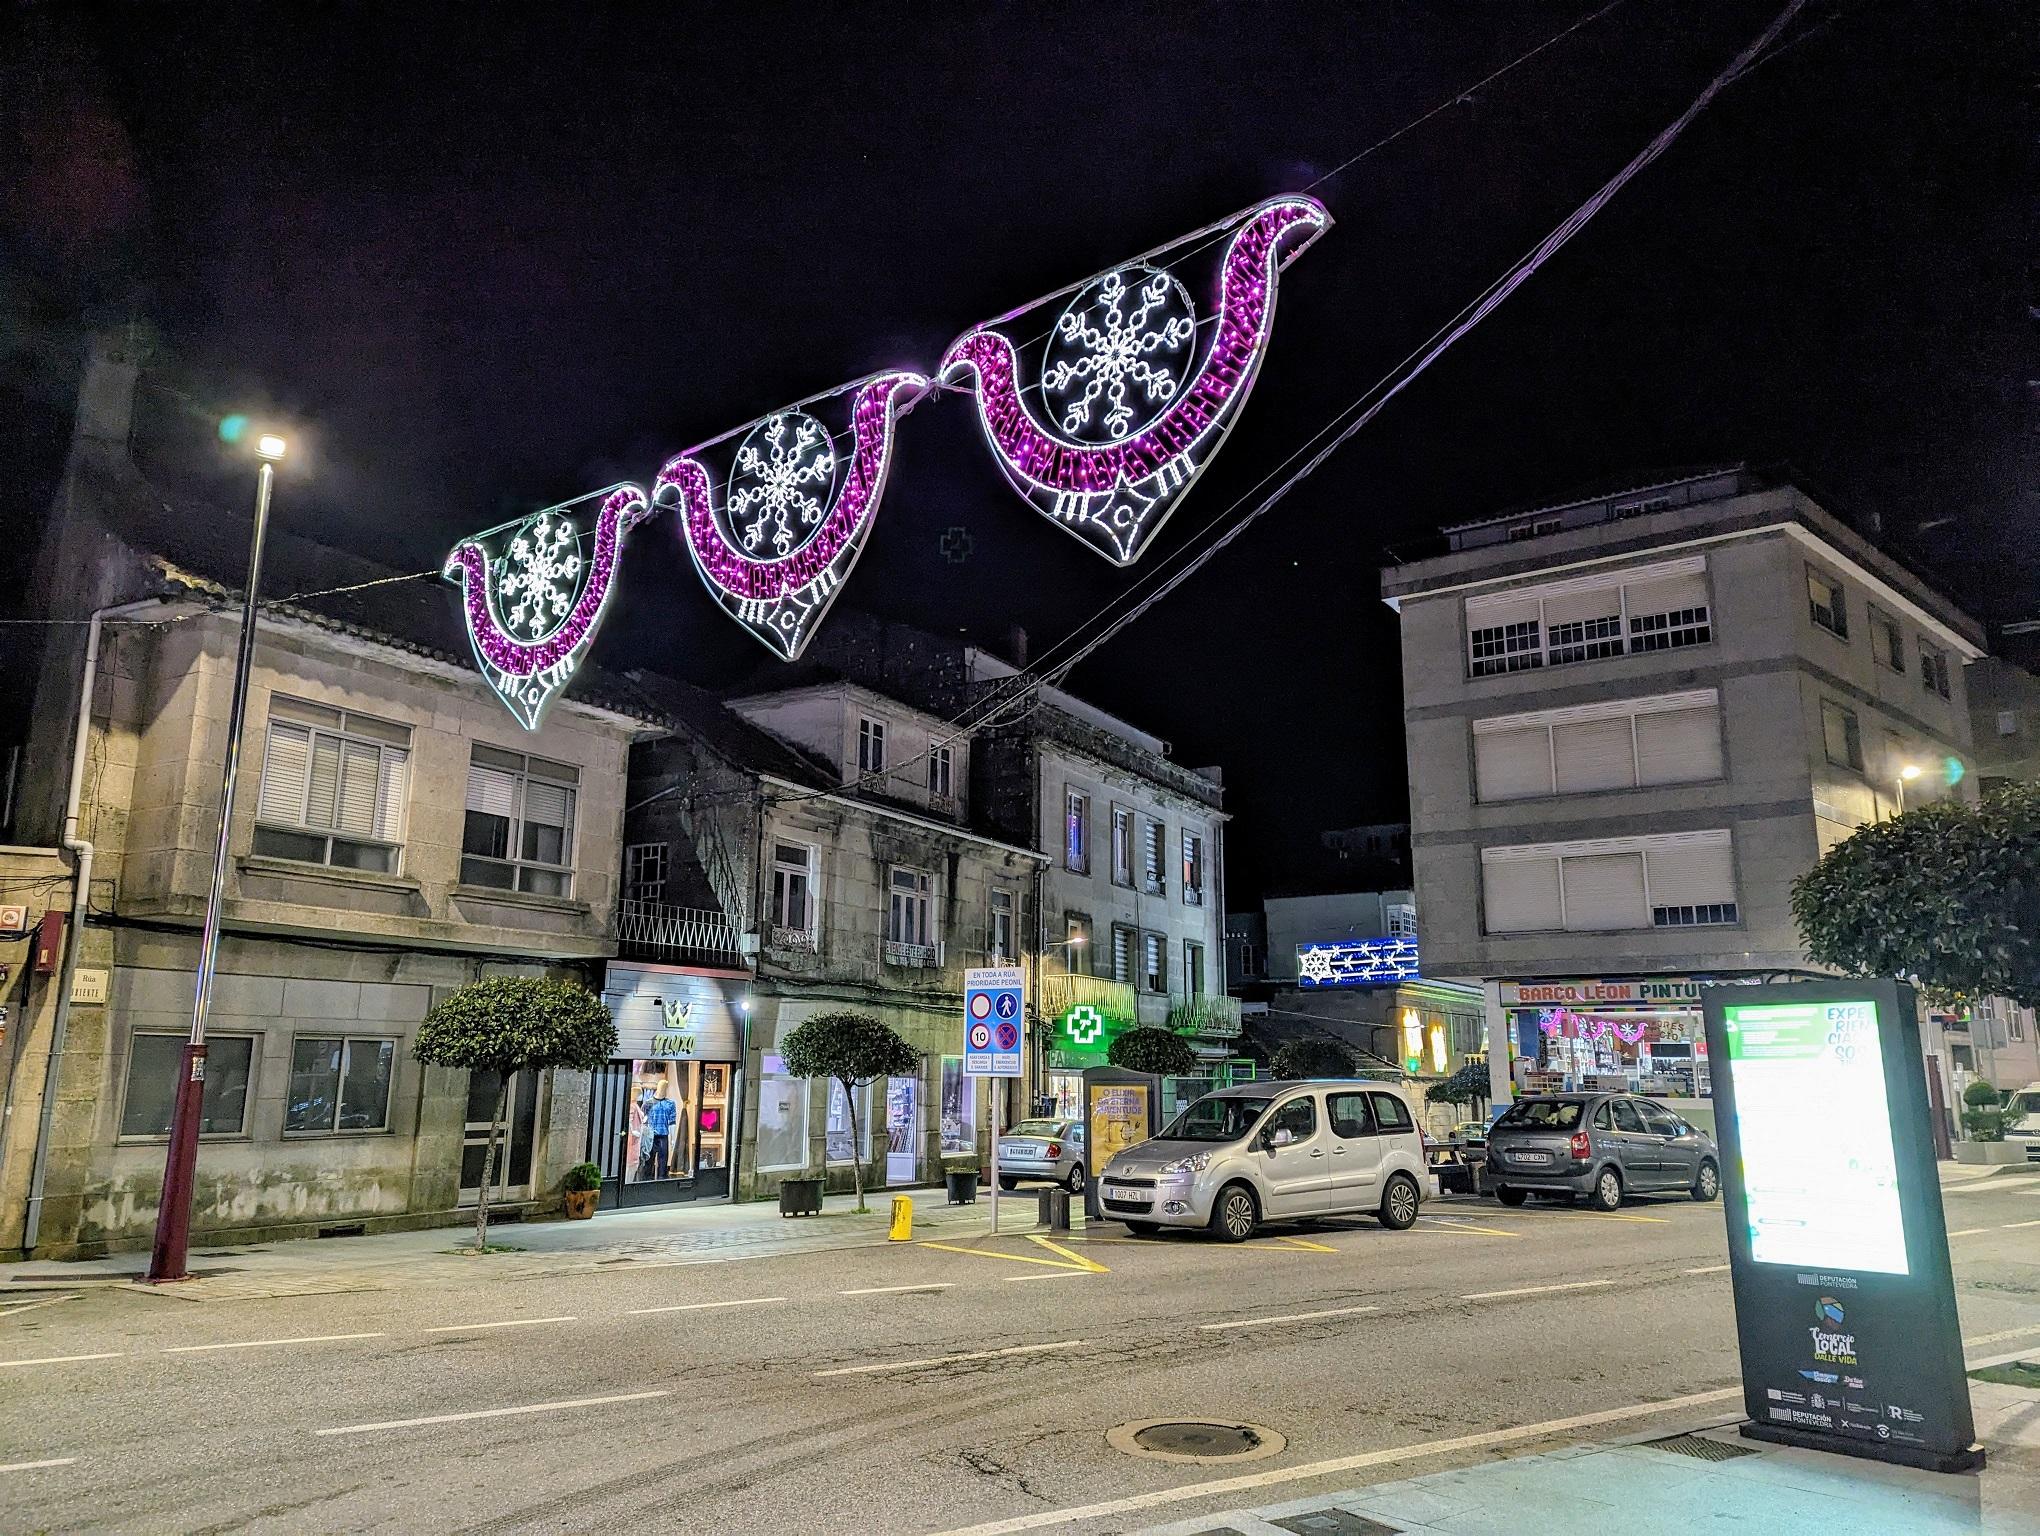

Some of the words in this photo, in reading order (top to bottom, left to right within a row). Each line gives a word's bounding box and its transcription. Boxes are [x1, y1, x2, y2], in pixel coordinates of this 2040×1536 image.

[966, 979, 1000, 987] PRIORIDADE
[1519, 986, 1576, 1001] BARCO
[1828, 1007, 1865, 1020] EXPE
[975, 1032, 986, 1042] 10
[1103, 1089, 1110, 1097] O
[1112, 1089, 1135, 1097] ELIXIR
[1820, 1275, 1857, 1284] DEPUTACIÓN
[1820, 1281, 1858, 1289] PONTEVEDRA
[1809, 1327, 1855, 1343] Comercio
[1815, 1340, 1856, 1355] LOCAL
[1814, 1353, 1837, 1362] DALLE
[1838, 1356, 1858, 1365] VIDA
[1792, 1410, 1832, 1422] DEPUTACIÓN
[1792, 1417, 1833, 1429] PONTEVEDRA
